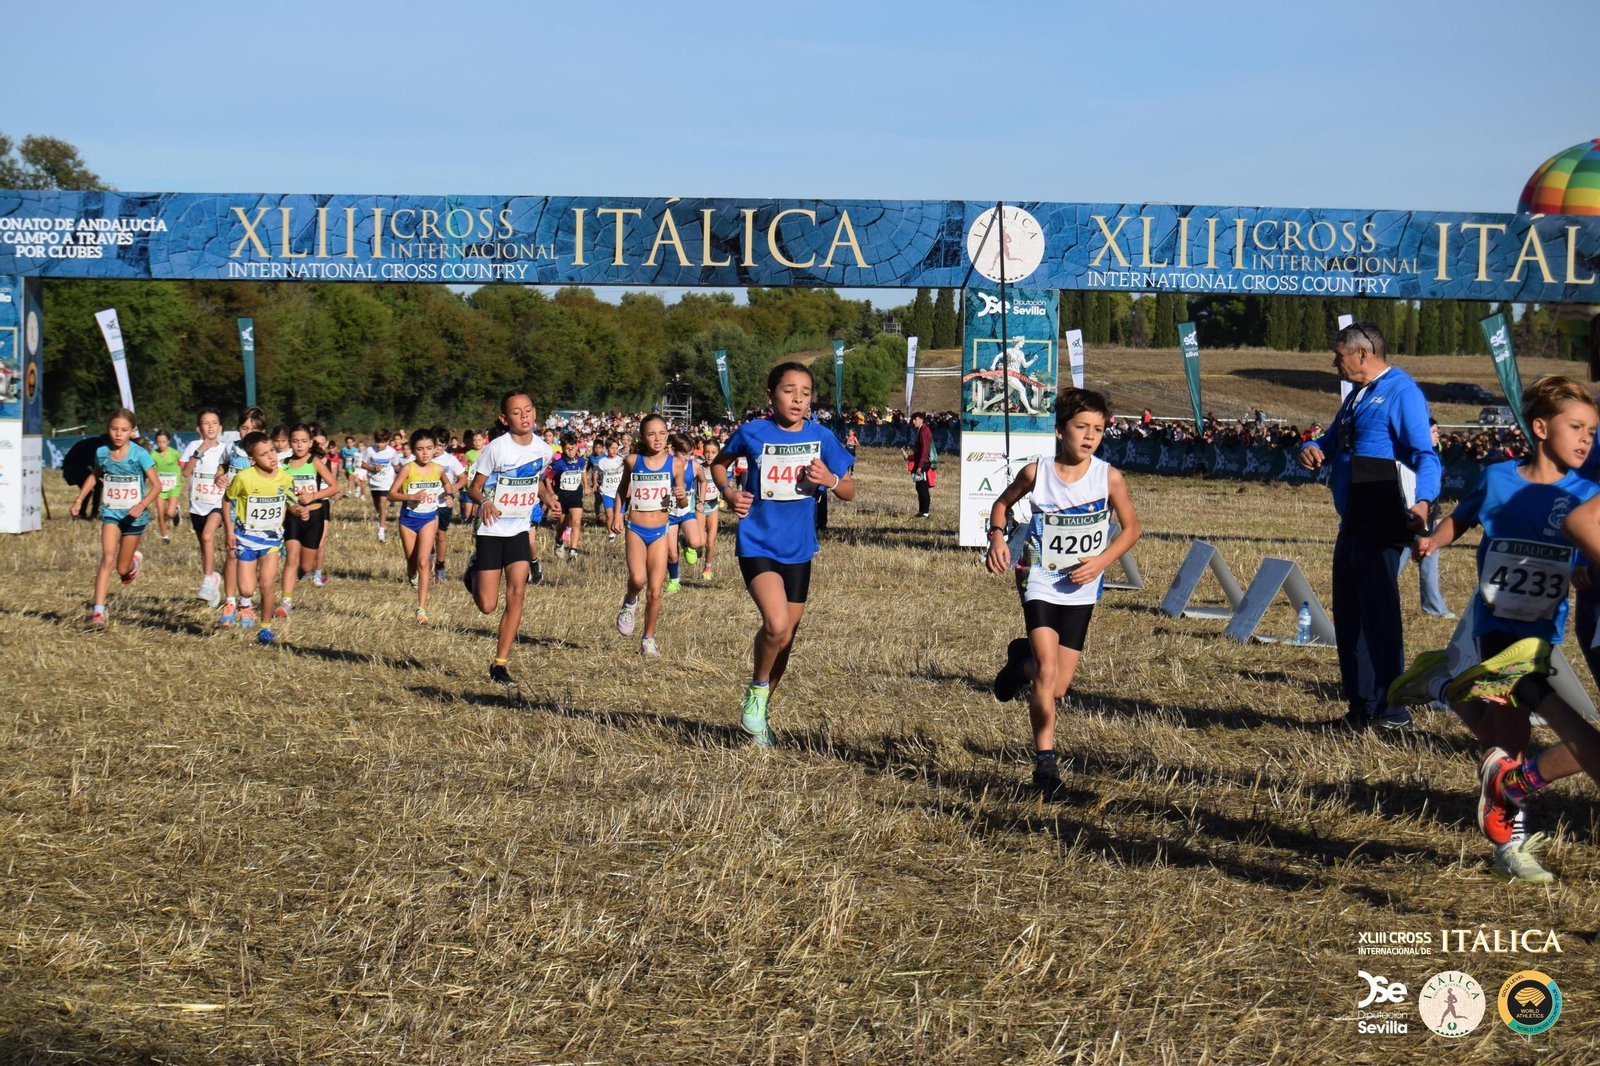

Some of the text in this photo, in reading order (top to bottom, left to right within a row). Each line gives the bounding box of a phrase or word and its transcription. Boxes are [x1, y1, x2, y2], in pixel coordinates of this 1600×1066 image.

[0, 216, 167, 232] ONATO DE ANDALUCÍA
[390, 208, 513, 239] CROSS
[570, 196, 872, 268] ITÁLICA
[3, 229, 133, 245] CAMPO A TRAVÉS
[228, 207, 387, 259] XLIII
[1253, 219, 1377, 253] CROSS
[390, 242, 558, 260] INTERNACIONAL
[1088, 215, 1248, 270] XLIII
[1433, 213, 1596, 285] ITÁL
[15, 245, 103, 259] POR CLUBES
[228, 262, 529, 280] INTERNATIONAL CROSS COUNTRY
[1252, 254, 1422, 275] INTERNACIONAL
[1087, 271, 1391, 294] INTERNATIONAL CROSS COUNTRY
[1013, 298, 1047, 309] Diputación
[1013, 305, 1047, 316] Sevilla
[779, 446, 807, 454] ITÁLICA
[107, 488, 138, 500] 4379
[499, 492, 536, 506] 4418
[634, 487, 668, 500] 4370
[251, 507, 282, 520] 4293
[1063, 516, 1095, 526] ITÁLICA
[1049, 530, 1103, 554] 4209
[1512, 543, 1555, 558] ITÁLICA
[1489, 565, 1563, 599] 4233
